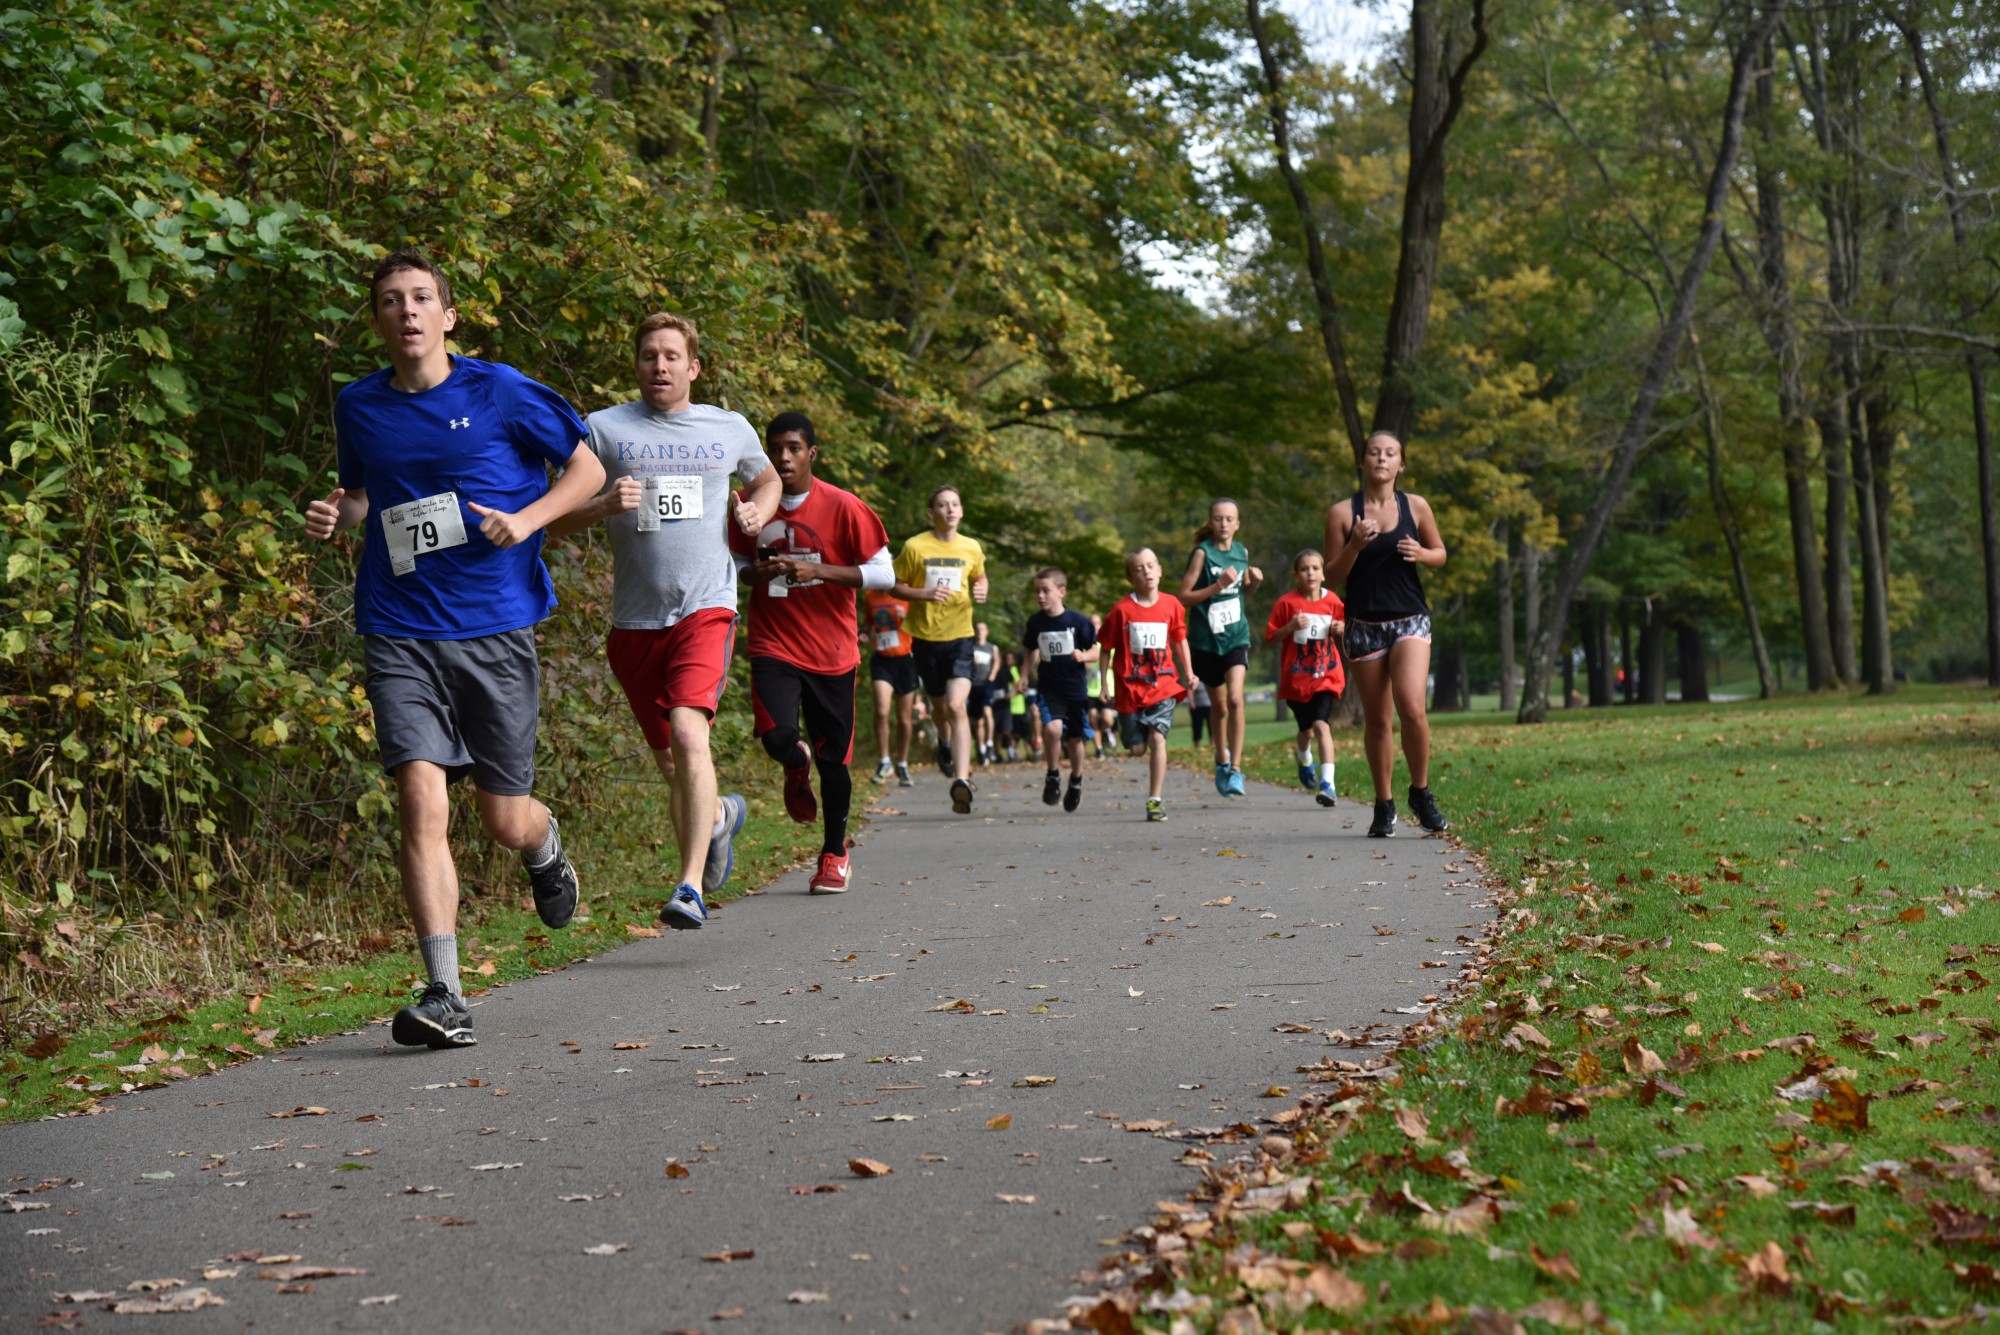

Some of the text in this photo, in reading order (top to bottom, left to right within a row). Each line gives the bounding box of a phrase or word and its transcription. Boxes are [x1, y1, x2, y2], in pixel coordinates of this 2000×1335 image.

[616, 441, 725, 461] KANSAS
[640, 464, 709, 472] BASKETBALL
[658, 494, 683, 516] 56
[406, 520, 439, 551] 79
[1220, 610, 1233, 624] 31
[1310, 624, 1318, 638] 6
[1142, 633, 1157, 647] 10
[1048, 641, 1063, 654] 60
